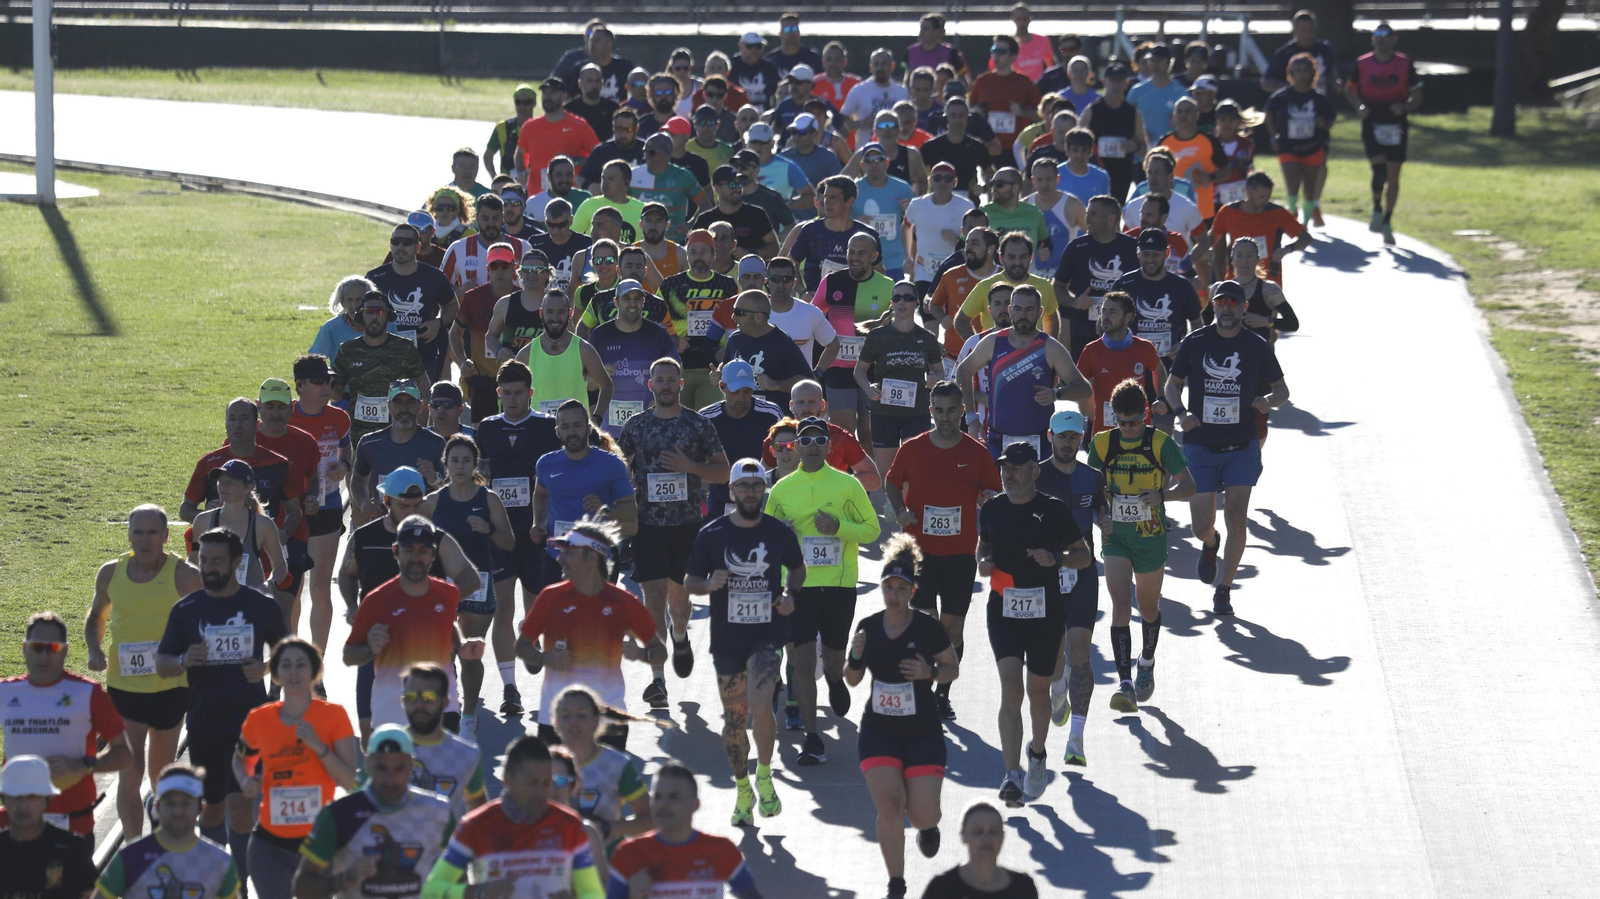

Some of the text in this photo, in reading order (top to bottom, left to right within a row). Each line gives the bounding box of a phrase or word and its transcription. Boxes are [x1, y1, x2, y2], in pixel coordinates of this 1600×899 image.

[396, 315, 423, 323] ARATÓN
[1016, 353, 1038, 369] JIMENA
[1005, 362, 1034, 382] RUNNERS
[1204, 382, 1241, 392] MARATÓN
[890, 389, 903, 400] 98
[361, 405, 378, 417] 180
[615, 410, 633, 421] 136
[1213, 407, 1226, 418] 46
[499, 488, 518, 500] 264
[656, 483, 675, 495] 250
[1119, 505, 1139, 516] 143
[930, 517, 950, 529] 263
[813, 547, 827, 558] 94
[728, 579, 769, 589] MARATÓN
[737, 603, 758, 616] 211
[1011, 599, 1032, 611] 217
[215, 637, 240, 651] 216
[130, 654, 145, 668] 40
[880, 694, 901, 709] 243
[28, 716, 71, 727] TRIATLÓN
[11, 727, 60, 735] ALGECIRAS
[281, 801, 306, 816] 214
